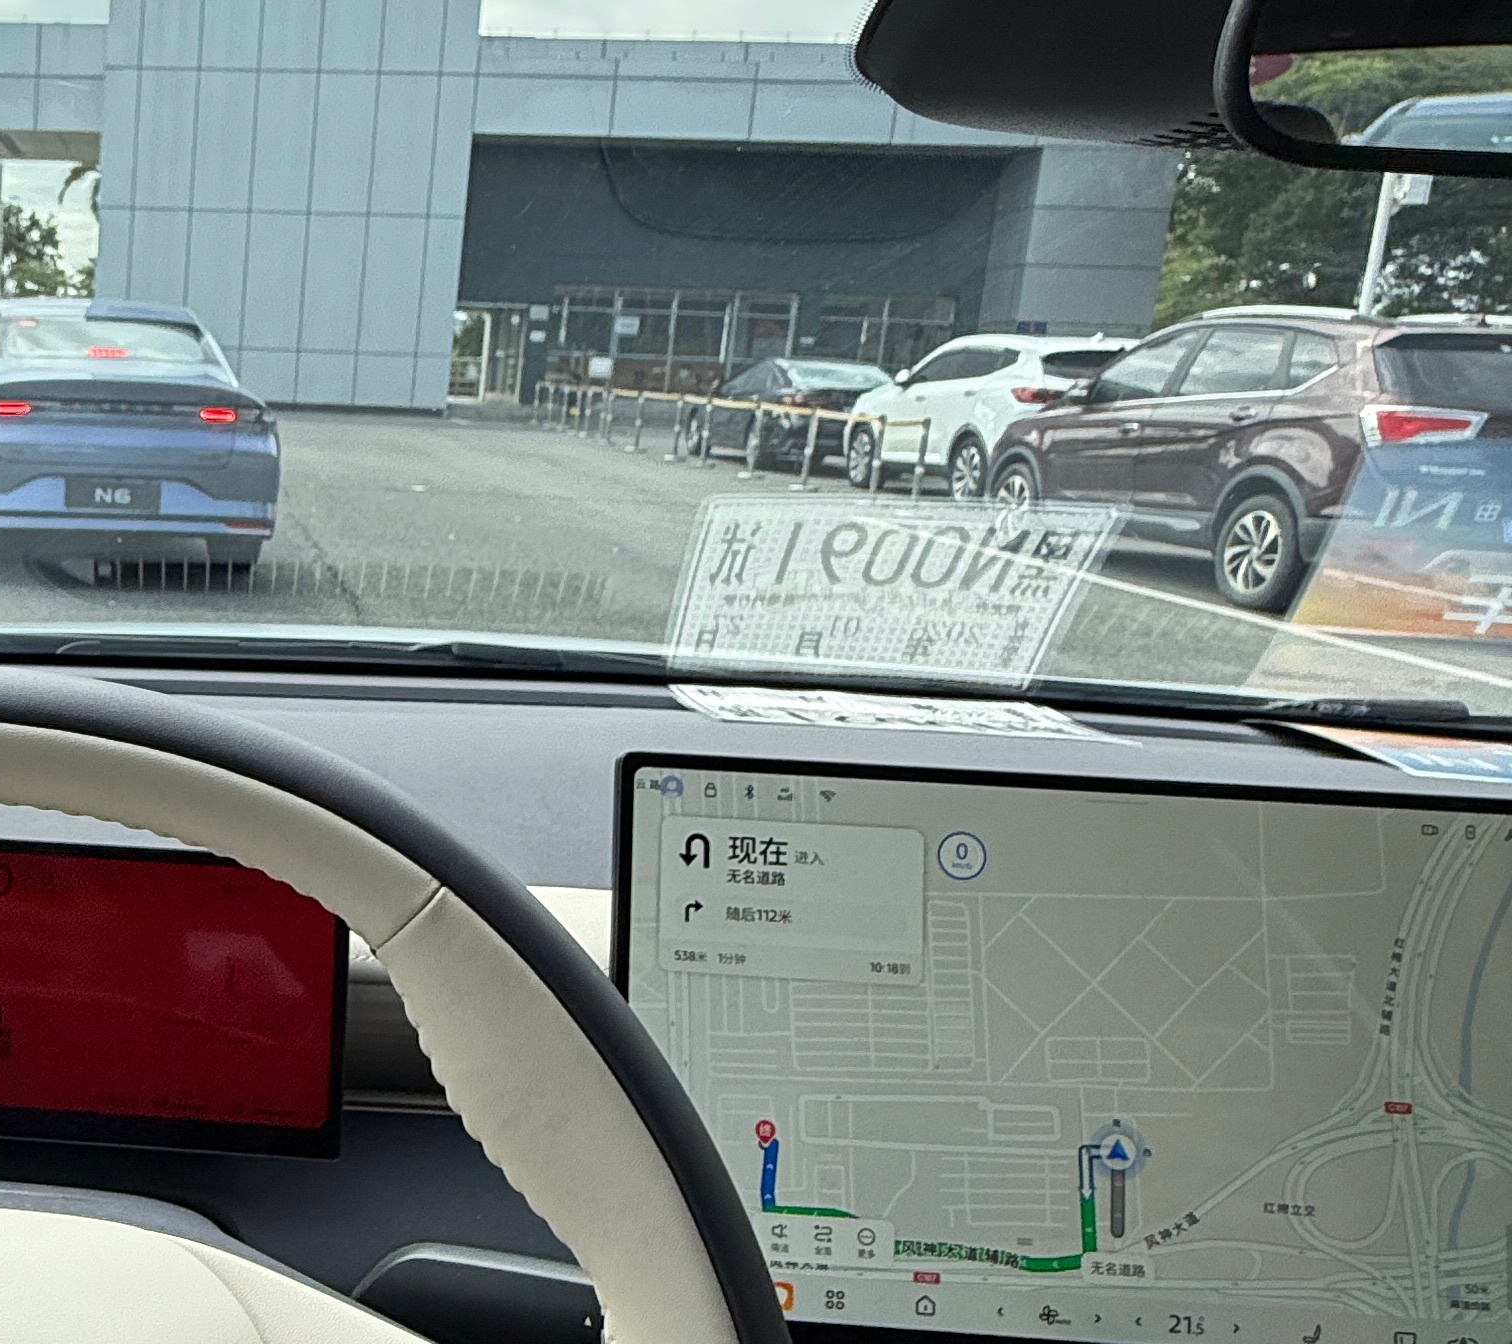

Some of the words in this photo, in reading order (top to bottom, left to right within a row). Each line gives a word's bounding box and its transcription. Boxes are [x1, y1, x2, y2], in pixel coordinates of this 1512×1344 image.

[728, 835, 789, 867] 现在
[794, 850, 825, 866] 进入
[955, 842, 969, 860] 0
[726, 869, 786, 887] 无名道路
[725, 906, 792, 924] 随后112米
[1144, 1211, 1201, 1251] 风神大道
[1090, 1260, 1146, 1279] 无名道路
